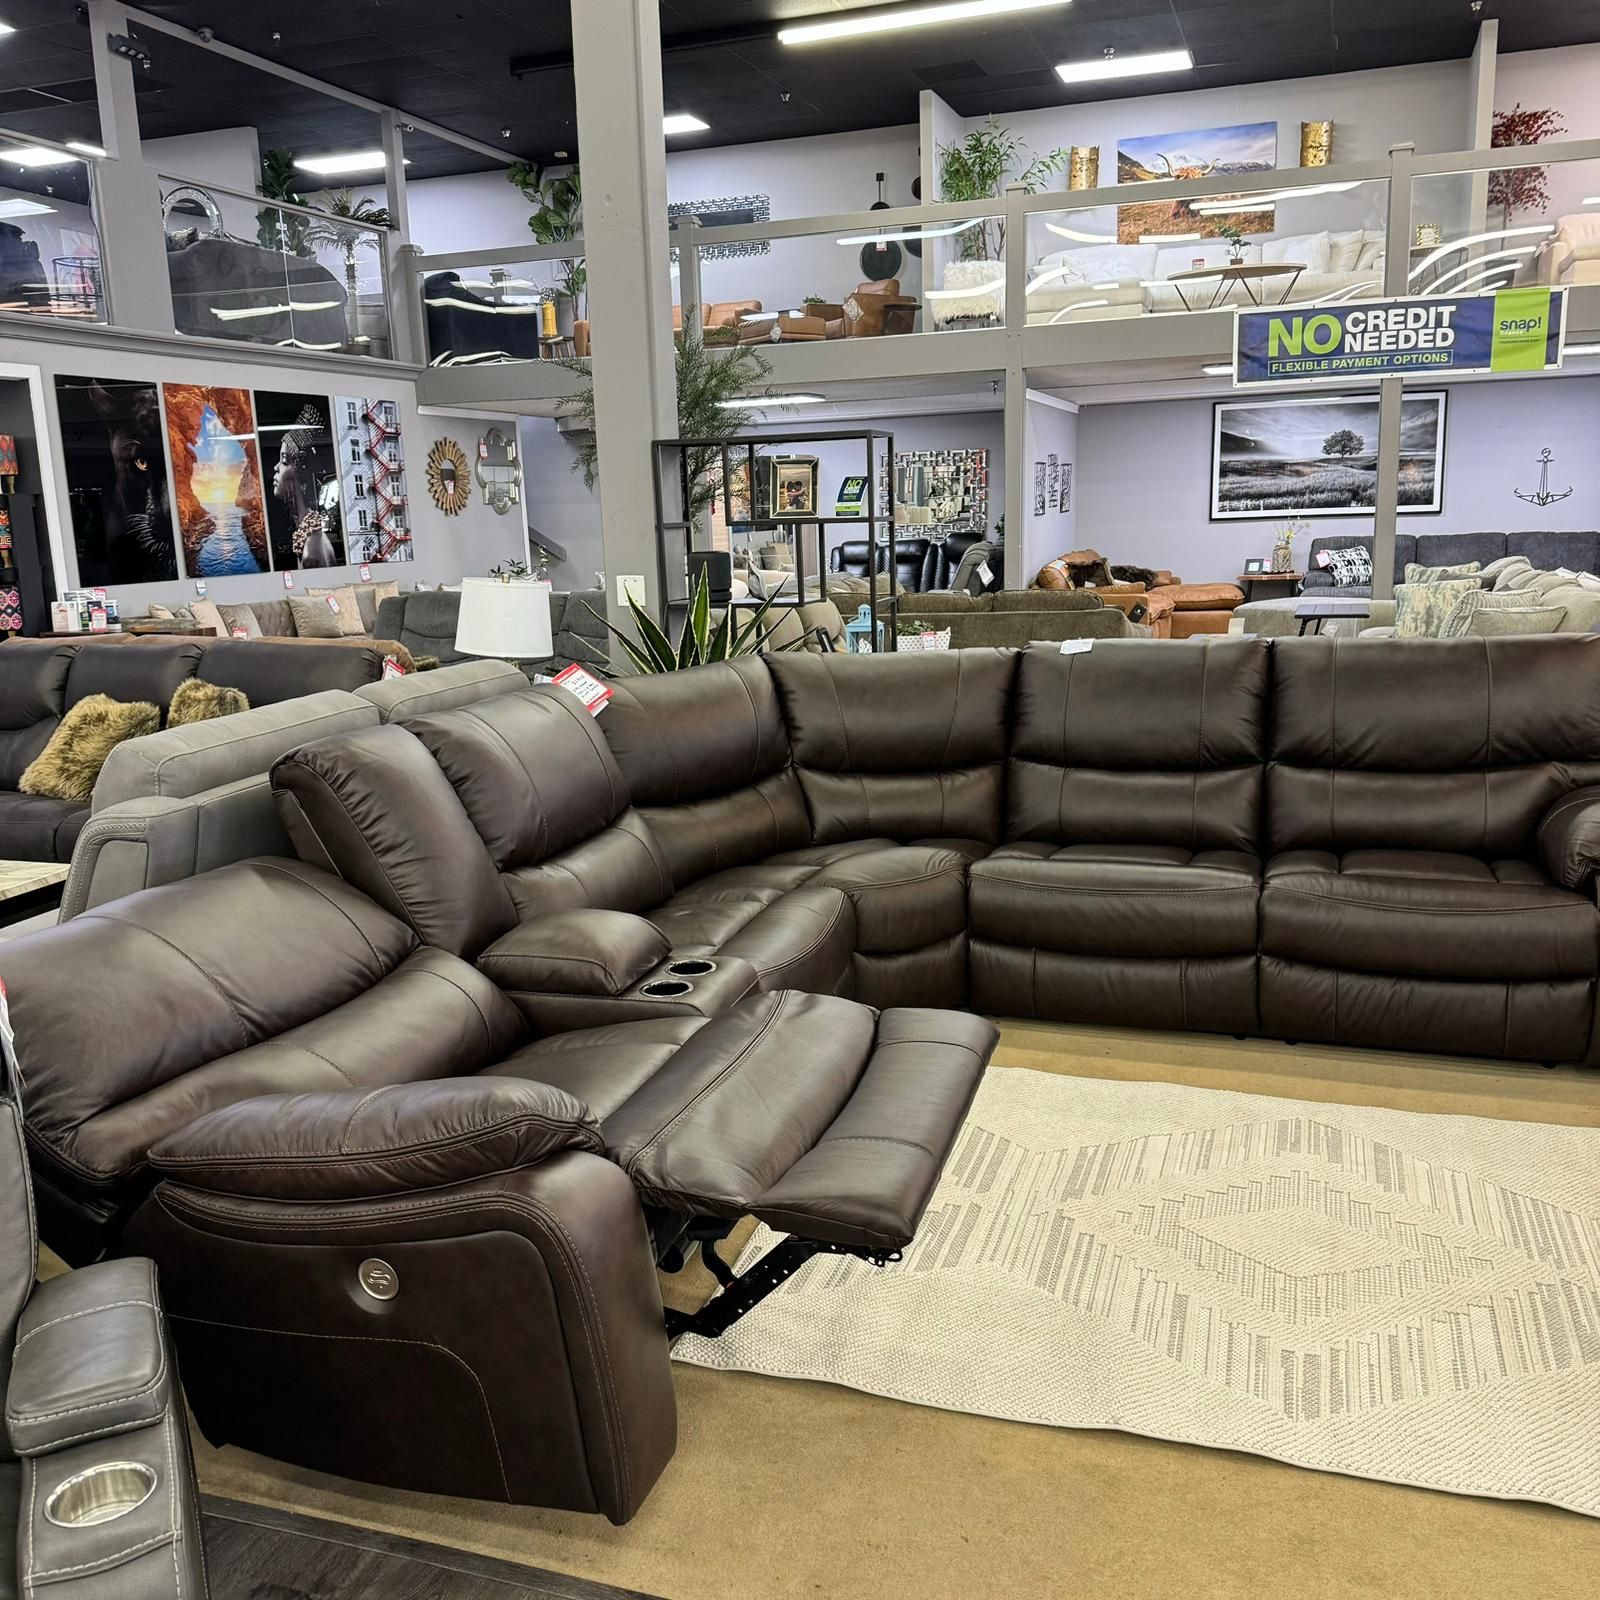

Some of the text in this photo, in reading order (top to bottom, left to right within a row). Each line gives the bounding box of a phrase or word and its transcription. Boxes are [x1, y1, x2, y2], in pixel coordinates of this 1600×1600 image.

[1345, 305, 1457, 334] CREDIT
[1500, 316, 1542, 332] snap!
[1268, 314, 1342, 357] NO
[1344, 327, 1455, 354] NEEDED
[1272, 353, 1449, 373] FLEXIBLE PAYMENT OPTIONS
[846, 479, 863, 487] NO
